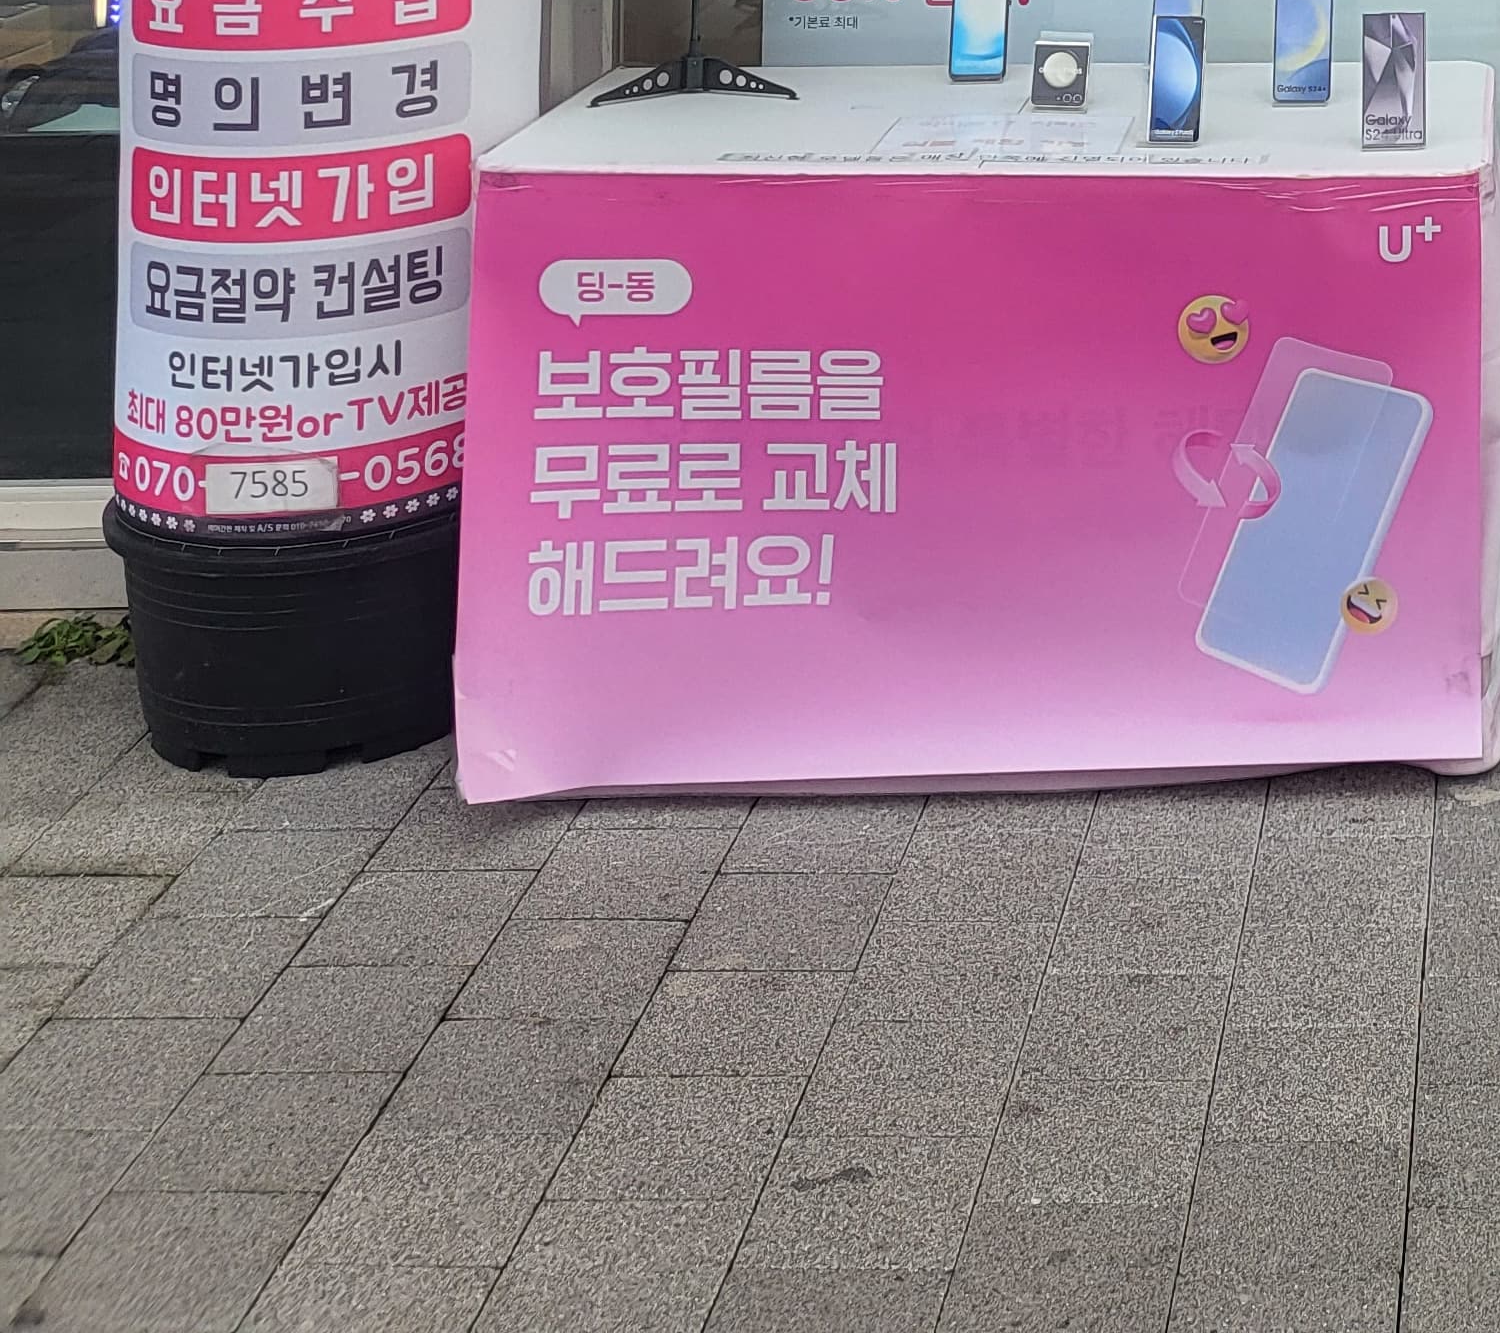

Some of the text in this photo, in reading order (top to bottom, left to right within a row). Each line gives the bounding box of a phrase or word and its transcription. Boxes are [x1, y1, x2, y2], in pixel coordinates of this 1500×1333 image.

[833, 15, 859, 30] 최대
[1276, 83, 1307, 95] Galaxy
[1364, 112, 1412, 131] Galaxy
[1377, 215, 1442, 263] U+
[145, 244, 445, 325] 요금절약 컨설팅
[576, 270, 656, 304] 딩-동
[167, 338, 403, 394] 인터넷가입시
[532, 346, 885, 421] 보호필름을
[126, 388, 167, 434] 최대
[528, 439, 898, 520] 무료로 교체
[527, 533, 836, 617] 해드려요!
